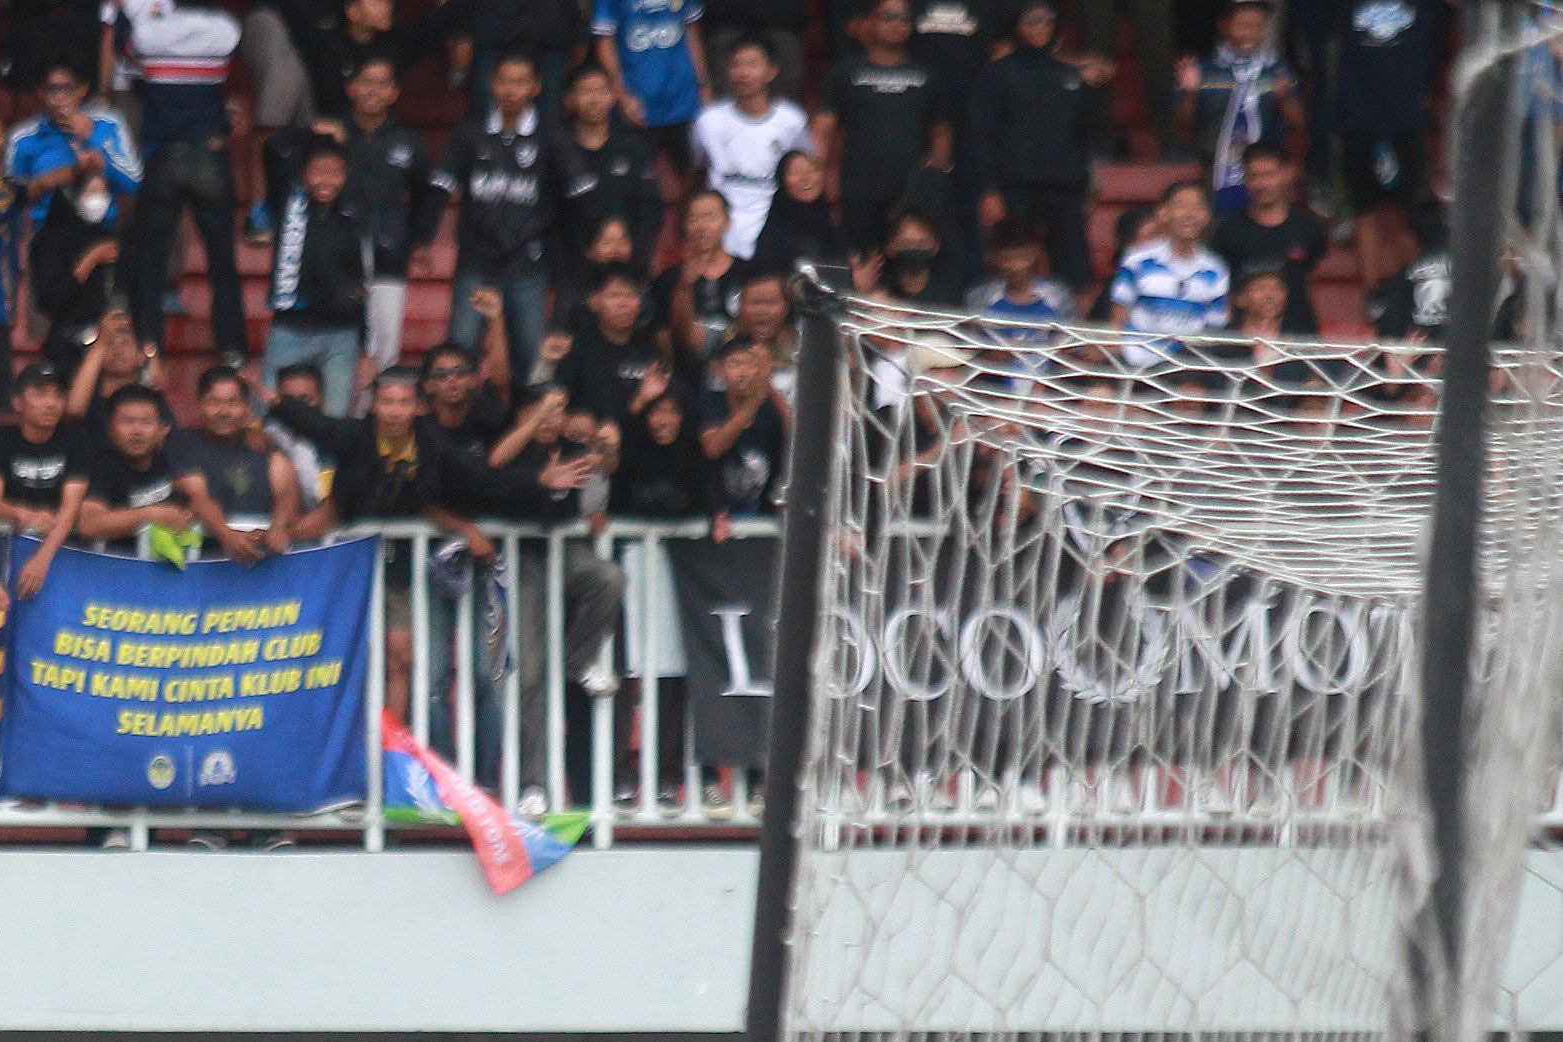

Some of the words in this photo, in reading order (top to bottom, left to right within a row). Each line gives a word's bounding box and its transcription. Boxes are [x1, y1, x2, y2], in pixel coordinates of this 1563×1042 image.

[82, 604, 199, 635] SEORANG
[201, 600, 302, 634] PEMAIN
[54, 631, 112, 663] BISA
[116, 638, 260, 668] BERPINDAH
[263, 628, 324, 662] CLUB
[31, 659, 88, 693] TAPI
[91, 672, 161, 702] KAMI
[163, 675, 235, 703] CINTA
[239, 668, 305, 698] KLUB
[305, 659, 343, 690] INI
[116, 705, 265, 737] SELAMANYA
